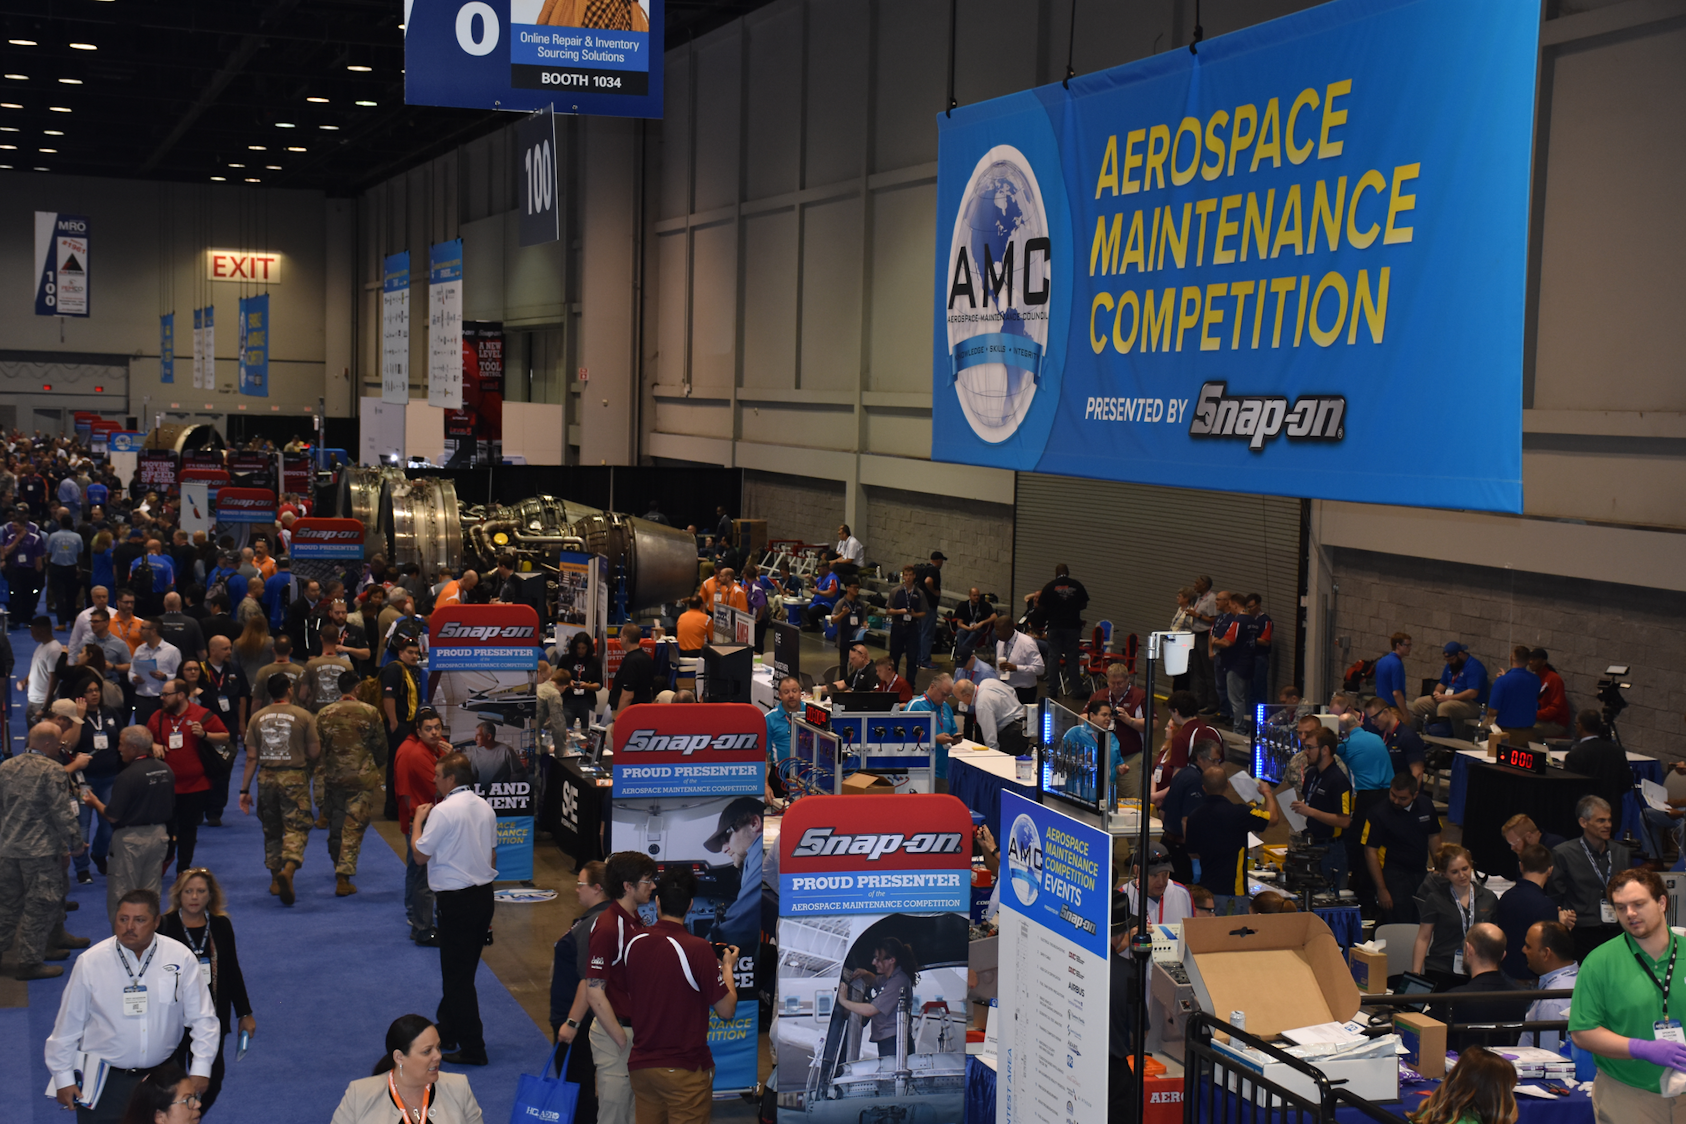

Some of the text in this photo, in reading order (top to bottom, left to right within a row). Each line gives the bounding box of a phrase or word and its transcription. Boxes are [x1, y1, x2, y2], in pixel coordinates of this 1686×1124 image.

[520, 31, 639, 52] Online Repair & Inventory
[537, 46, 625, 62] Sourcing Solutions
[541, 72, 622, 88] BOOTH 1034
[1095, 79, 1352, 199] AEROSPACE
[525, 139, 551, 215] 100
[58, 221, 86, 232] MRO
[1089, 162, 1420, 276] MAINTENANCE
[212, 255, 275, 279] EXIT
[948, 236, 1050, 310] AMC
[1089, 266, 1390, 355] COMPETITION
[479, 350, 502, 358] LEVEL
[480, 362, 502, 371] TOOL
[1085, 396, 1188, 424] PRESENTED BY
[1190, 381, 1346, 451] Snap-on
[221, 497, 272, 507] Snap-on
[295, 527, 360, 540] Snap-on
[437, 622, 535, 641] Snap-on
[436, 648, 533, 657] PROUD PRESENTER
[622, 729, 759, 756] Snap-on
[622, 765, 758, 778] PROUD PRESENTER
[489, 782, 530, 795] AND
[622, 787, 662, 795] AEROSPACE
[663, 786, 711, 794] MAINTENANCE
[562, 780, 578, 824] SAE
[791, 827, 963, 861] Snap-on
[1046, 826, 1089, 856] AEROSPACE
[1008, 837, 1043, 871] AMC
[1045, 841, 1098, 877] MAINTENANCE
[792, 874, 960, 891] PROUD PRESENTER
[1045, 857, 1095, 891] COMPETITION
[868, 890, 875, 898] of
[1045, 873, 1082, 907] EVENTS
[791, 899, 960, 911] AEROSPACE MAINTENANCE COMPETITION
[1060, 903, 1096, 936] Snap-on
[1067, 982, 1085, 997] AIRBUS
